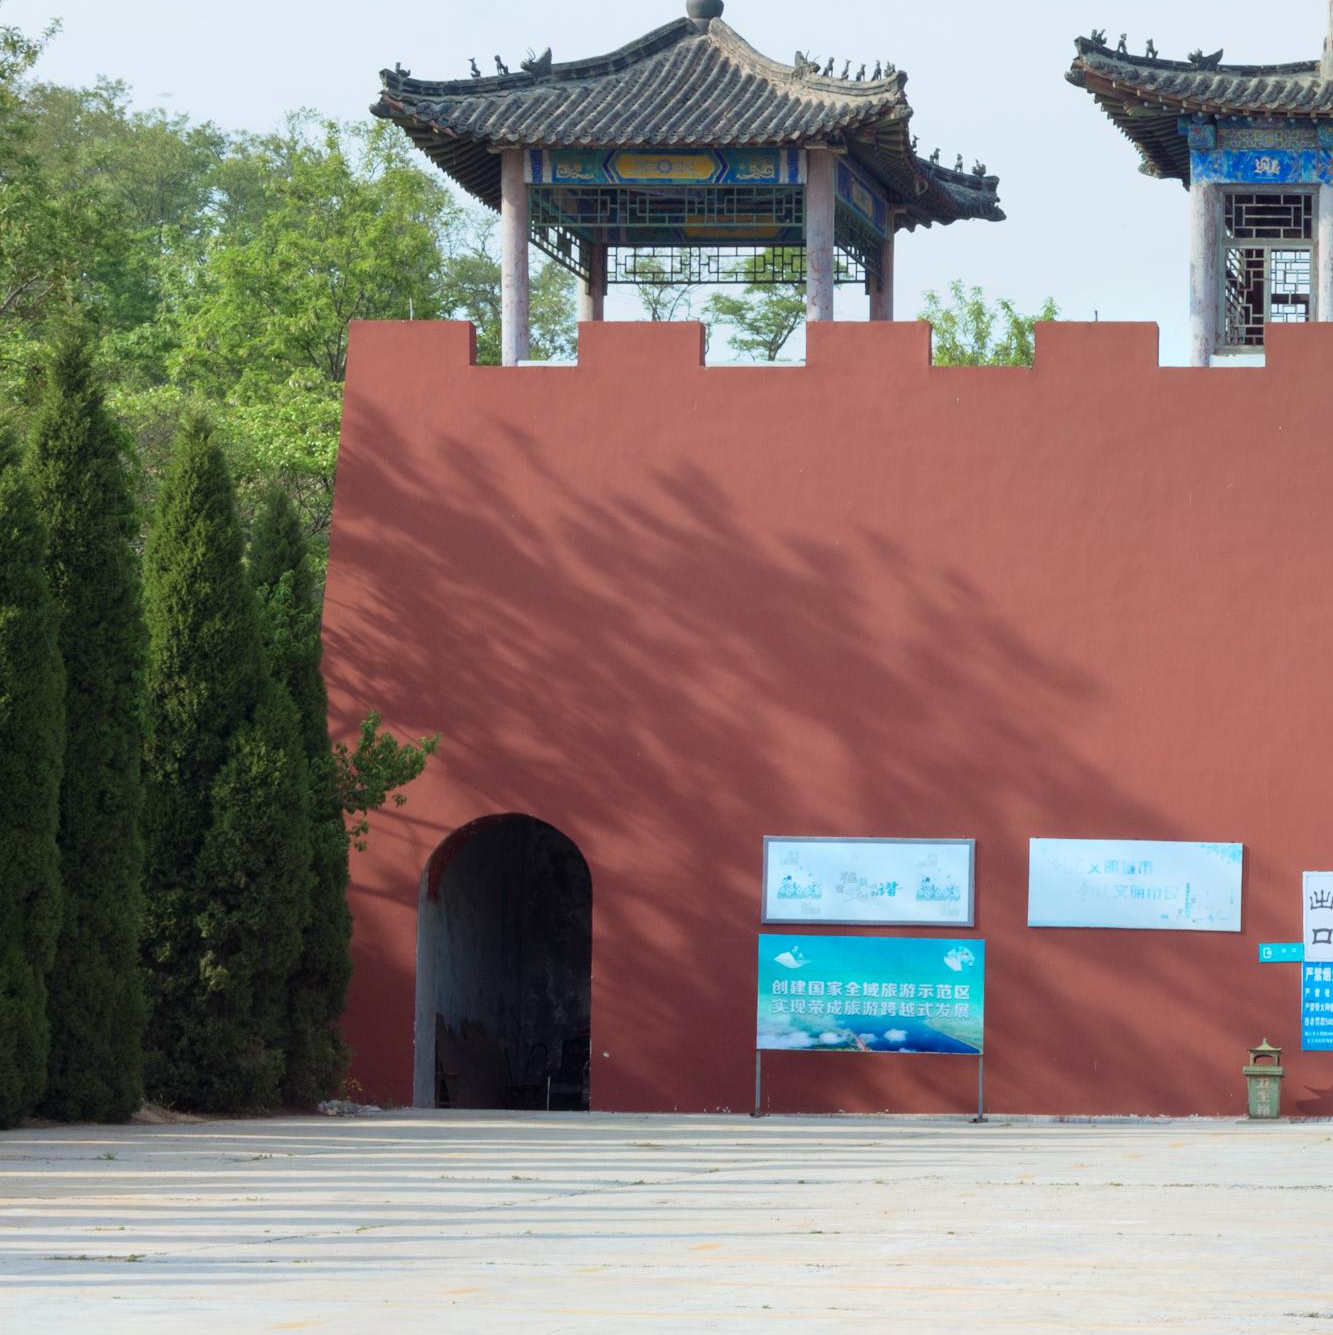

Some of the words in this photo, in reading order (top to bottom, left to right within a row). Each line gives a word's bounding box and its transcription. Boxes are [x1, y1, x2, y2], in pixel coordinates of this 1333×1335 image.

[772, 979, 970, 1000] 创建国家全域旅游示范区
[772, 998, 970, 1018] 实现荣成旅游跨越式发展
